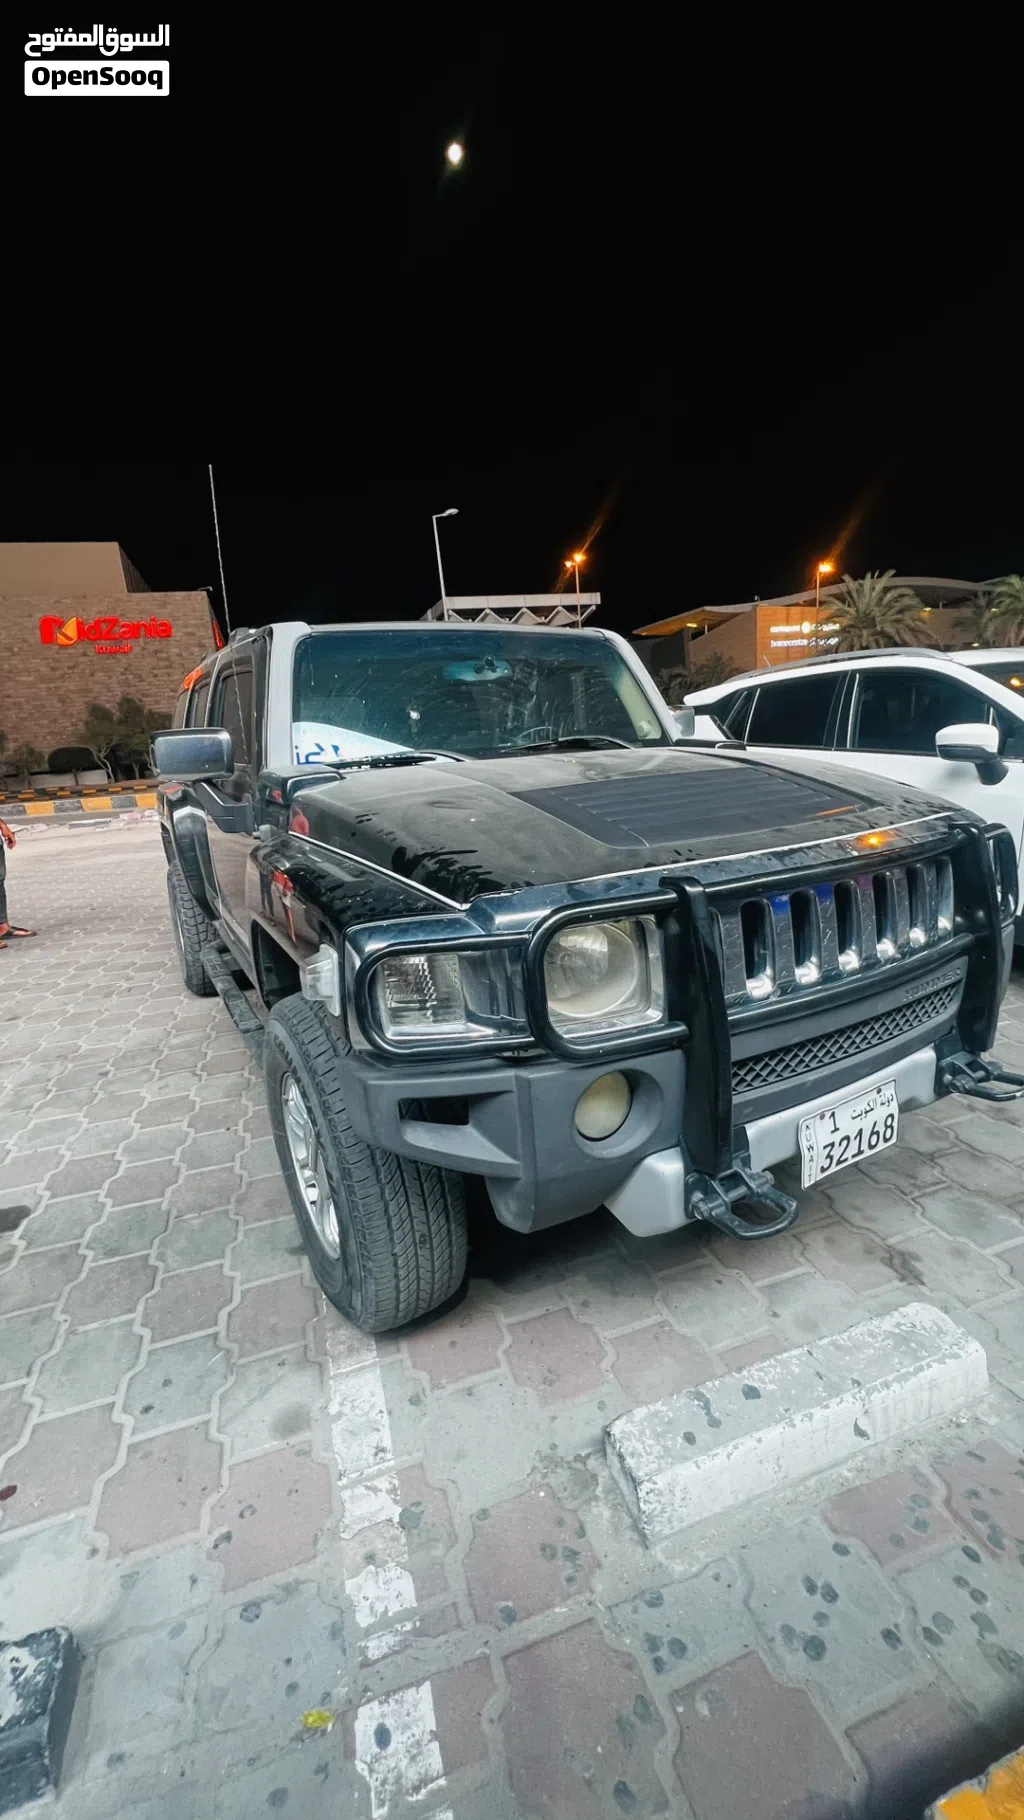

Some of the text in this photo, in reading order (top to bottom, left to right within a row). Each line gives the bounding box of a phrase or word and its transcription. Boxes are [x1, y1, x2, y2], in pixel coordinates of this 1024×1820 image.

[40, 616, 172, 646] KidZania
[95, 643, 132, 654] Kuwait
[851, 1098, 877, 1120] الكويت
[829, 1111, 839, 1134] 1
[820, 1113, 894, 1174] 32168
